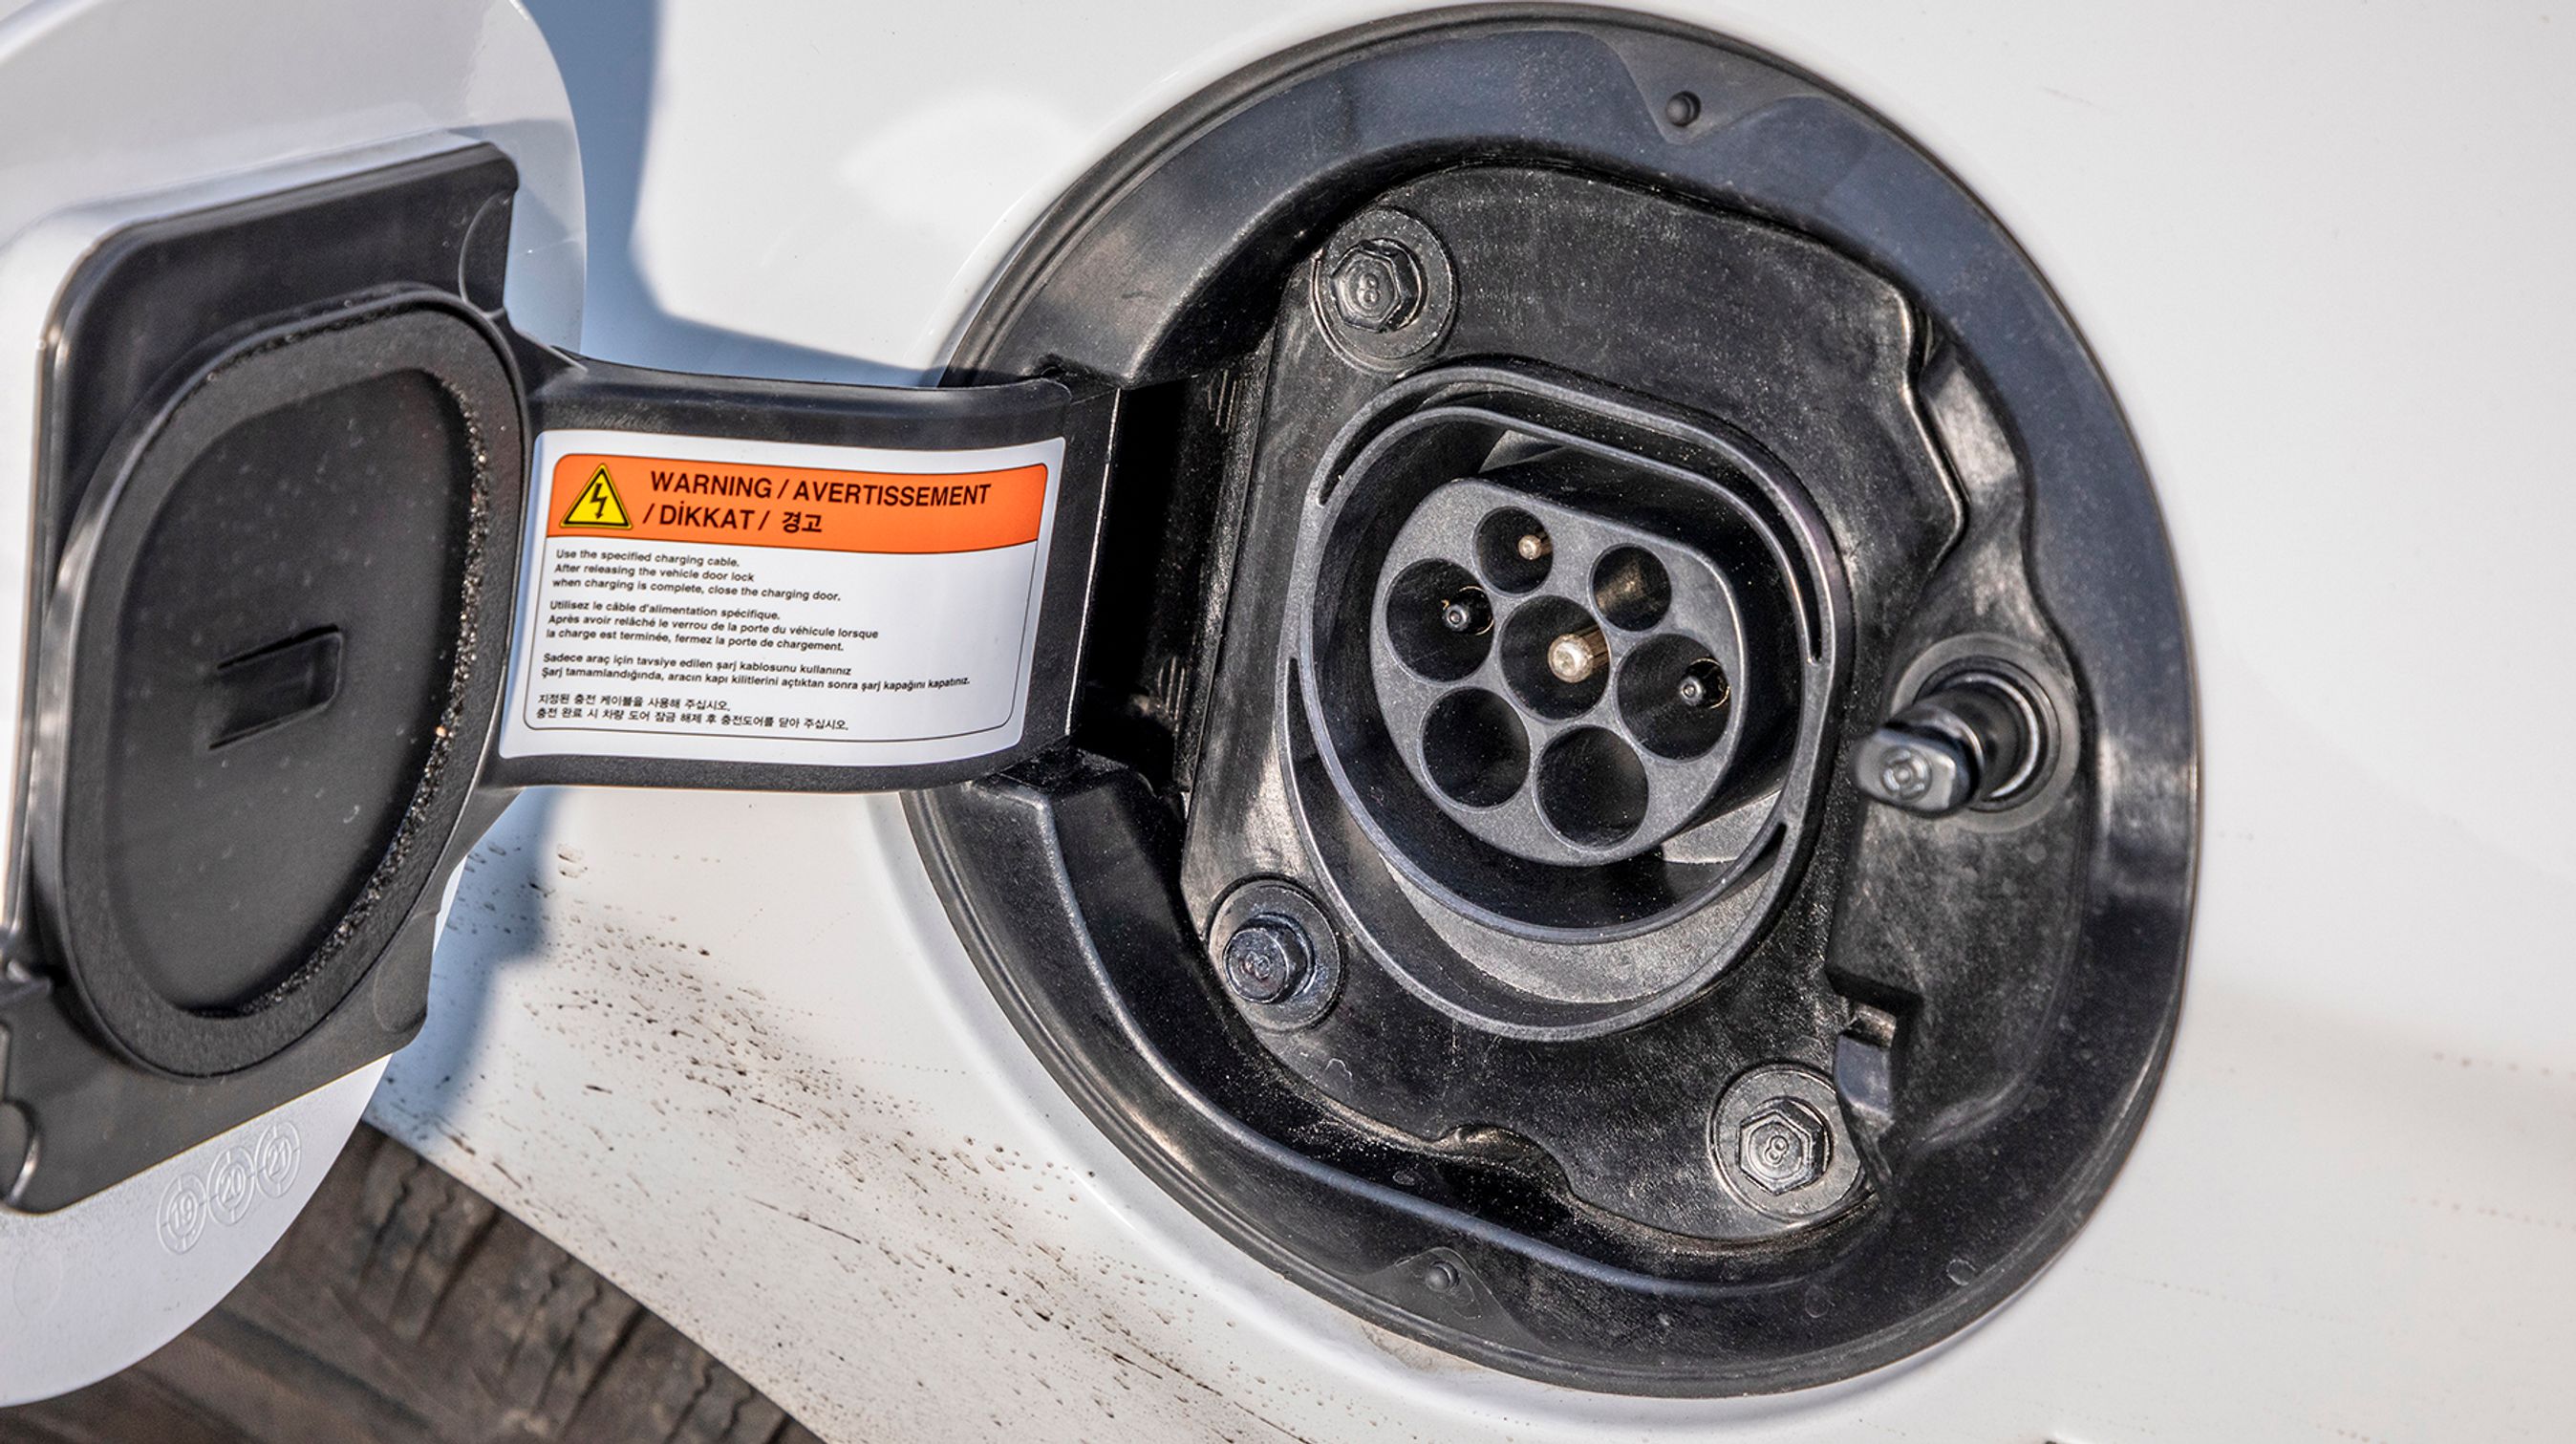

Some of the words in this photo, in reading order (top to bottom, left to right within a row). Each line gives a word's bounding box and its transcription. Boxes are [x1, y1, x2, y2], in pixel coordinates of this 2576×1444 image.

[652, 471, 771, 498] WARNING
[777, 479, 789, 499] /
[793, 481, 991, 506] AVERTISSEMENT
[643, 504, 655, 524] /
[659, 500, 755, 529] DİKKAT
[759, 510, 770, 530] /
[783, 511, 822, 533] 경고
[556, 550, 577, 559] Use
[580, 550, 597, 559] the
[600, 551, 652, 562] specified
[655, 553, 704, 568] charging
[707, 557, 740, 568] cable.
[554, 564, 581, 573] After
[584, 564, 635, 578] releasing
[638, 567, 656, 576] the
[659, 569, 699, 579] vehicle
[701, 571, 729, 581] door
[731, 571, 754, 582] lock
[552, 578, 582, 587] when
[584, 578, 634, 592] charging
[637, 581, 647, 591] is
[650, 583, 704, 594] complete,
[707, 585, 739, 595] close
[741, 587, 759, 596] the
[761, 588, 810, 602] charging
[812, 591, 841, 601] door.
[549, 600, 590, 611] Utilisez
[592, 601, 603, 611] le
[605, 602, 636, 613] câble
[638, 604, 718, 616] d'alimentation
[720, 608, 780, 621] spécifique.
[547, 614, 580, 626] Après
[583, 615, 612, 625] avoir
[614, 616, 656, 628] relâché
[658, 618, 669, 628] le
[672, 621, 708, 630] verrou
[711, 621, 725, 632] de
[727, 622, 738, 632] la
[740, 624, 770, 634] porte
[771, 625, 786, 635] du
[789, 626, 836, 637] véhicule
[837, 628, 879, 640] lorsque
[546, 629, 556, 638] la
[558, 629, 597, 640] charge
[599, 631, 617, 639] est
[620, 631, 672, 643] terminée,
[675, 634, 713, 645] fermez
[715, 636, 725, 645] la
[727, 637, 758, 648] porte
[760, 637, 774, 648] de
[776, 639, 844, 652] chargement.
[543, 653, 584, 663] Sadece
[586, 655, 611, 666] araç
[612, 655, 633, 667] için
[636, 657, 676, 669] tavsiye
[679, 658, 713, 669] edilen
[716, 660, 737, 673] şarj
[740, 661, 797, 673] kablosunu
[799, 664, 851, 676] kullanınız
[541, 667, 563, 679] Şarj
[566, 667, 664, 681] tamamlandığında,
[667, 673, 702, 682] aracın
[705, 673, 729, 685] kapı
[731, 675, 779, 686] kilitlerini
[781, 678, 825, 689] açtıktan
[827, 680, 859, 690] sonra
[861, 680, 882, 693] şarj
[883, 680, 926, 692] kapağını
[928, 677, 970, 690] kapatınız.
[538, 693, 570, 705] 지정된
[573, 694, 596, 705] 충전
[600, 695, 644, 707] 케이블을
[648, 697, 681, 709] 사용해
[684, 699, 730, 712] 주십시오.
[536, 707, 558, 719] 충전
[561, 707, 583, 719] 완료
[587, 708, 599, 719] 시
[602, 709, 625, 721] 차량
[628, 710, 651, 722] 도어
[655, 711, 676, 722] 잠금
[679, 713, 702, 724] 해제
[705, 713, 717, 724] 후
[720, 714, 775, 727] 충전도어를
[779, 717, 800, 728] 닫아
[804, 718, 848, 731] 주십시오.
[171, 1196, 193, 1230] 19
[221, 1168, 242, 1204] 20
[268, 1139, 287, 1177] 21
